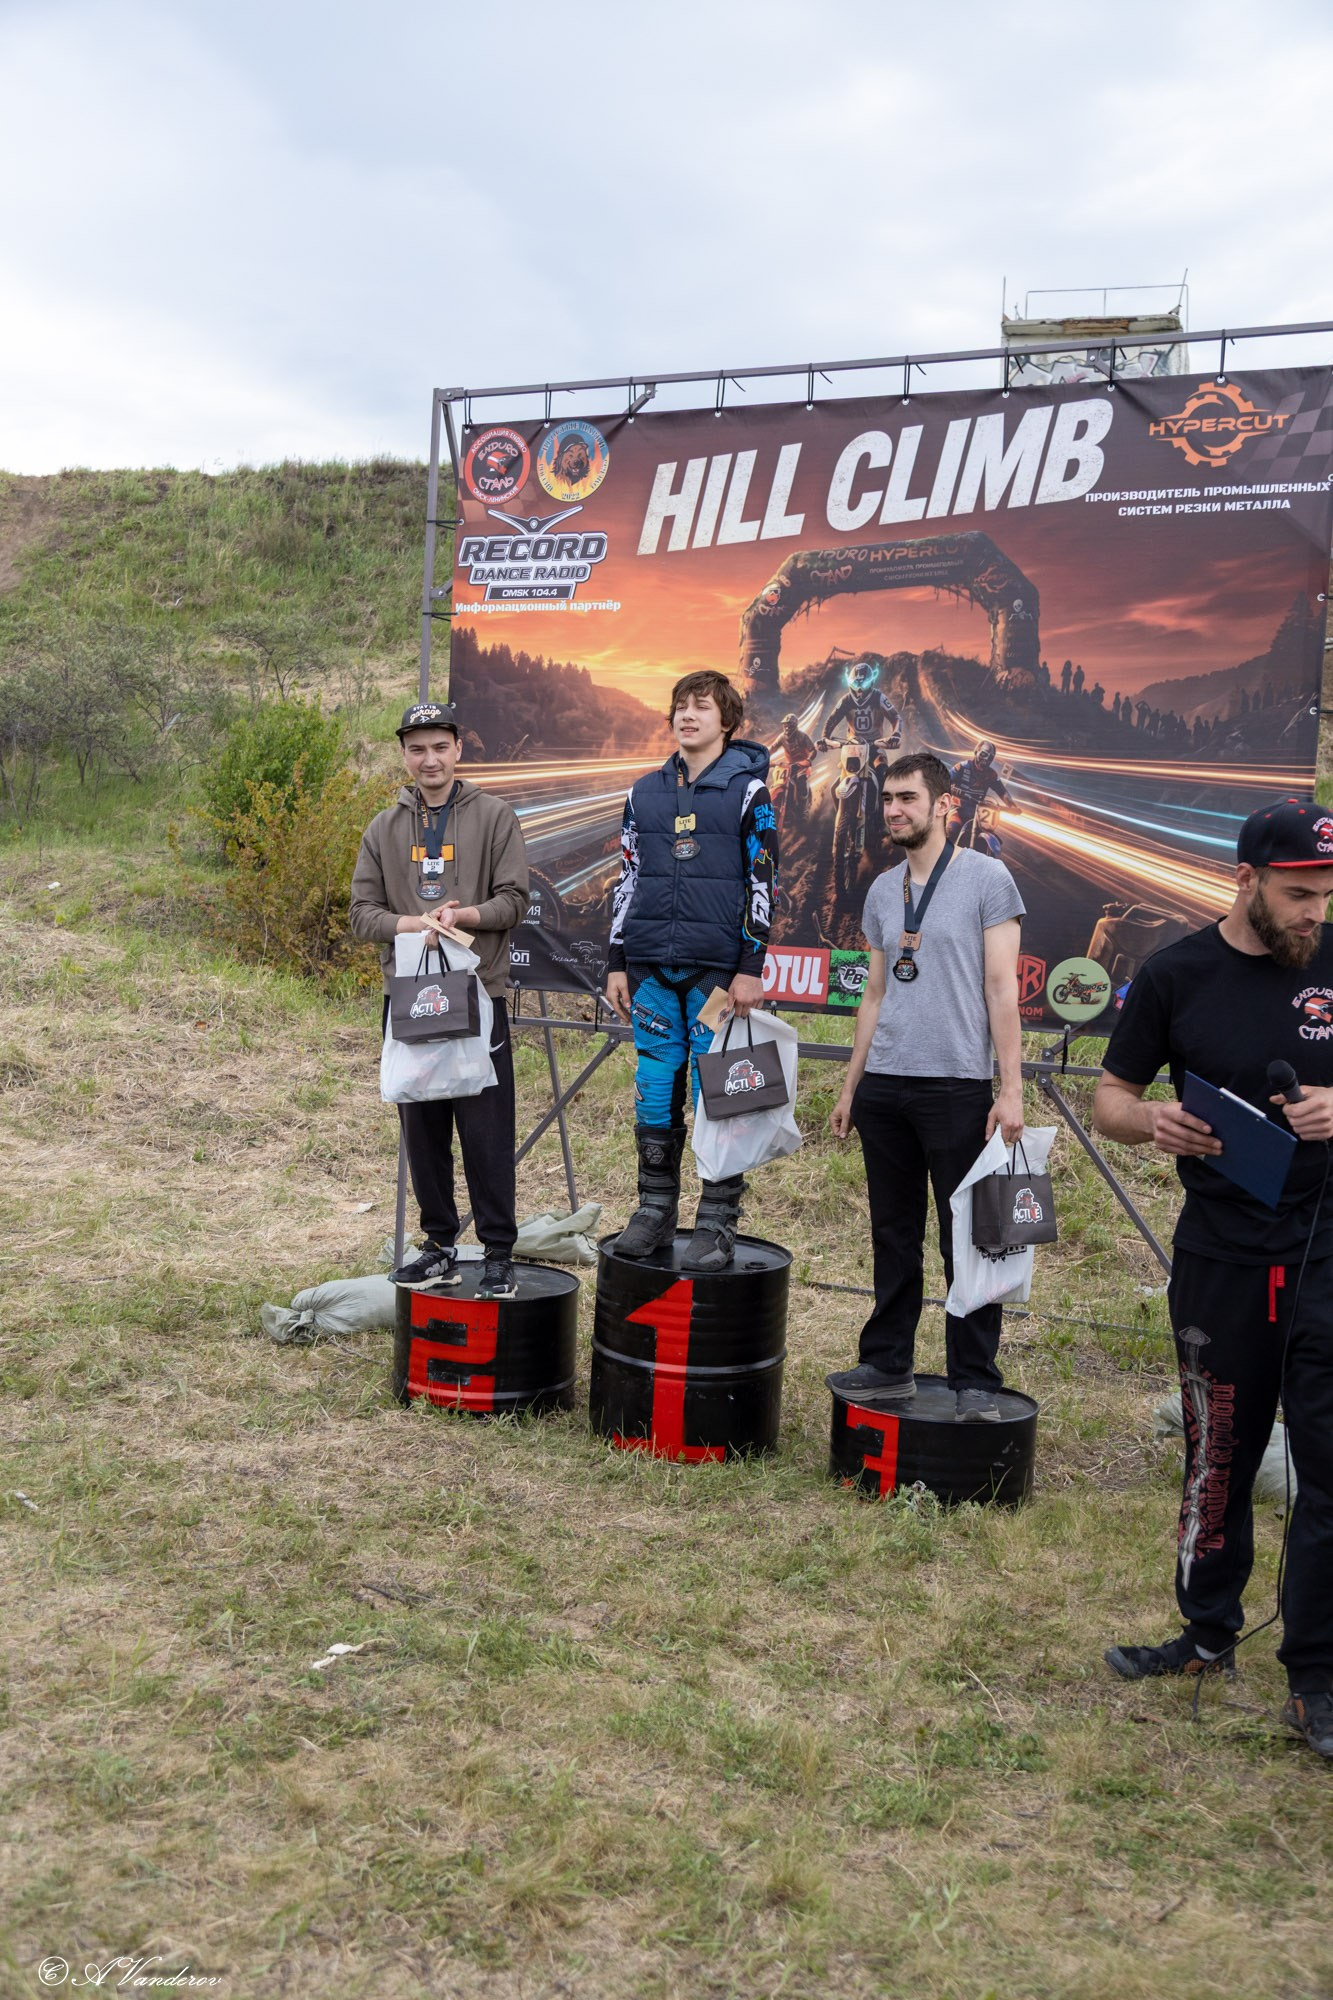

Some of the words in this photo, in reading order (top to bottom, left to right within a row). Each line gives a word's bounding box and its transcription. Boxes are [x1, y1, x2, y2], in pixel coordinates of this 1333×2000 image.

[1149, 414, 1291, 436] HYPERCUT
[478, 441, 519, 461] ENDURO
[637, 442, 806, 556] HILL
[825, 398, 1114, 532] CLIMB
[1085, 485, 1201, 503] ПРОИЗВОДИТЕЛЬ
[1203, 481, 1331, 497] ПРОМЫШЛЕННЫХ
[1118, 503, 1173, 517] СИСТЕМ
[1175, 502, 1221, 514] РЕЗКИ
[1224, 499, 1291, 512] МЕТАЛЛА
[459, 534, 607, 564] RECORD
[472, 566, 532, 582] DANCE
[533, 565, 588, 581] RADIO
[502, 589, 529, 597] OMSK
[531, 588, 557, 597] 104.4
[455, 601, 567, 613] Информационный
[569, 600, 621, 612] партнёр
[409, 709, 441, 723] garage
[761, 952, 823, 995] OTUL
[412, 996, 449, 1015] ACTIVE
[1291, 986, 1333, 1009] ENDUR
[726, 1073, 763, 1092] ACTIVE
[1014, 1204, 1041, 1220] ACTIVE
[407, 1291, 499, 1413] 2
[613, 1279, 727, 1463] 1
